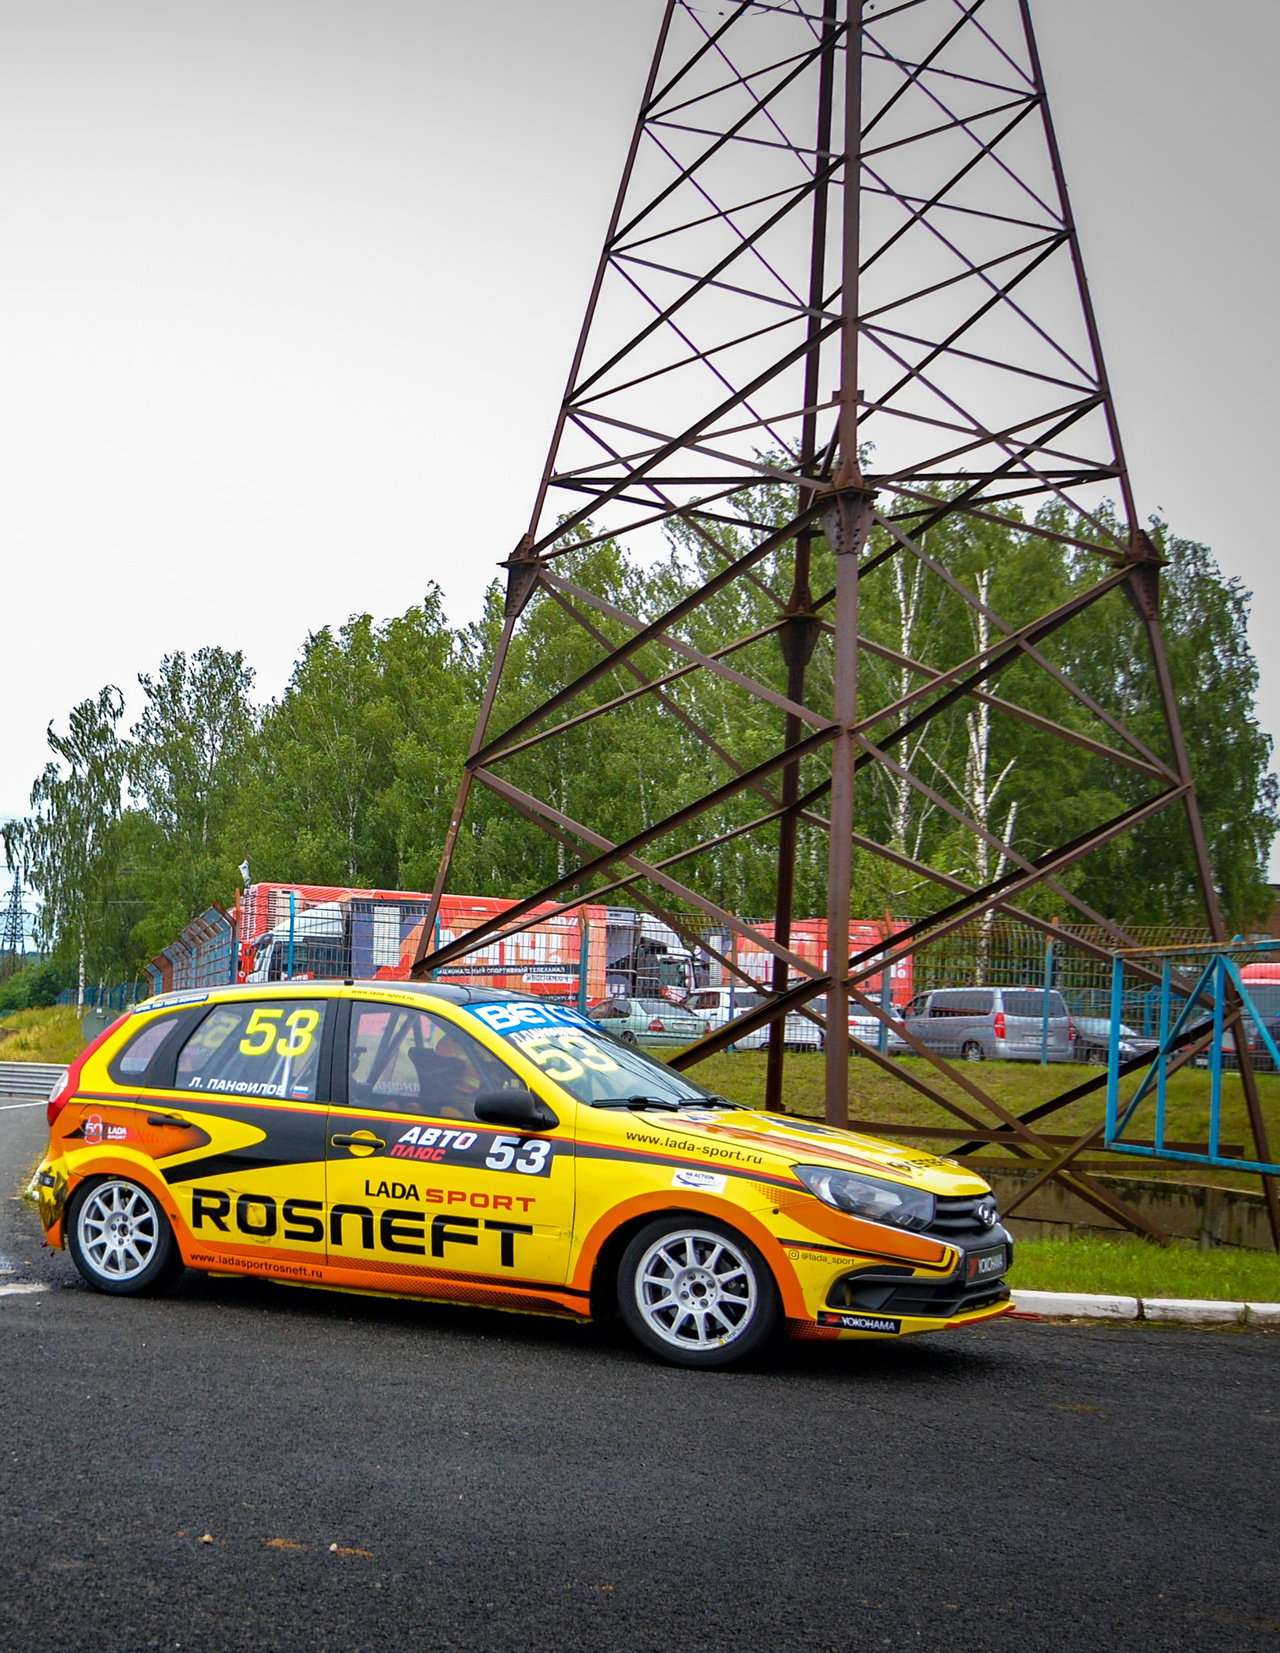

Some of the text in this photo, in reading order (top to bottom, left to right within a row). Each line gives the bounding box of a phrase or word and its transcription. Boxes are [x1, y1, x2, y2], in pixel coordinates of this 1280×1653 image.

[437, 965, 565, 975] АЦИОНАЛЬНЫЙ СПОРТИВНЫЙ ТЕЛЕКАНАЛ
[239, 1008, 320, 1057] 53
[517, 1036, 619, 1082] 53
[189, 1077, 284, 1096] Л. ПАНФИЛОВ
[108, 1127, 127, 1135] LADA
[398, 1126, 477, 1150] АВТО
[389, 1144, 446, 1161] ПЛЮС
[485, 1135, 552, 1174] 53
[626, 1131, 762, 1164] www.lada-sport.ru
[364, 1179, 536, 1212] LADA SPORT
[192, 1187, 534, 1268] ROSNEFT
[190, 1253, 323, 1278] www.ladasportrosneft.ru
[801, 1253, 855, 1266] @lada_sport
[841, 1316, 896, 1331] YOKOHAMA
